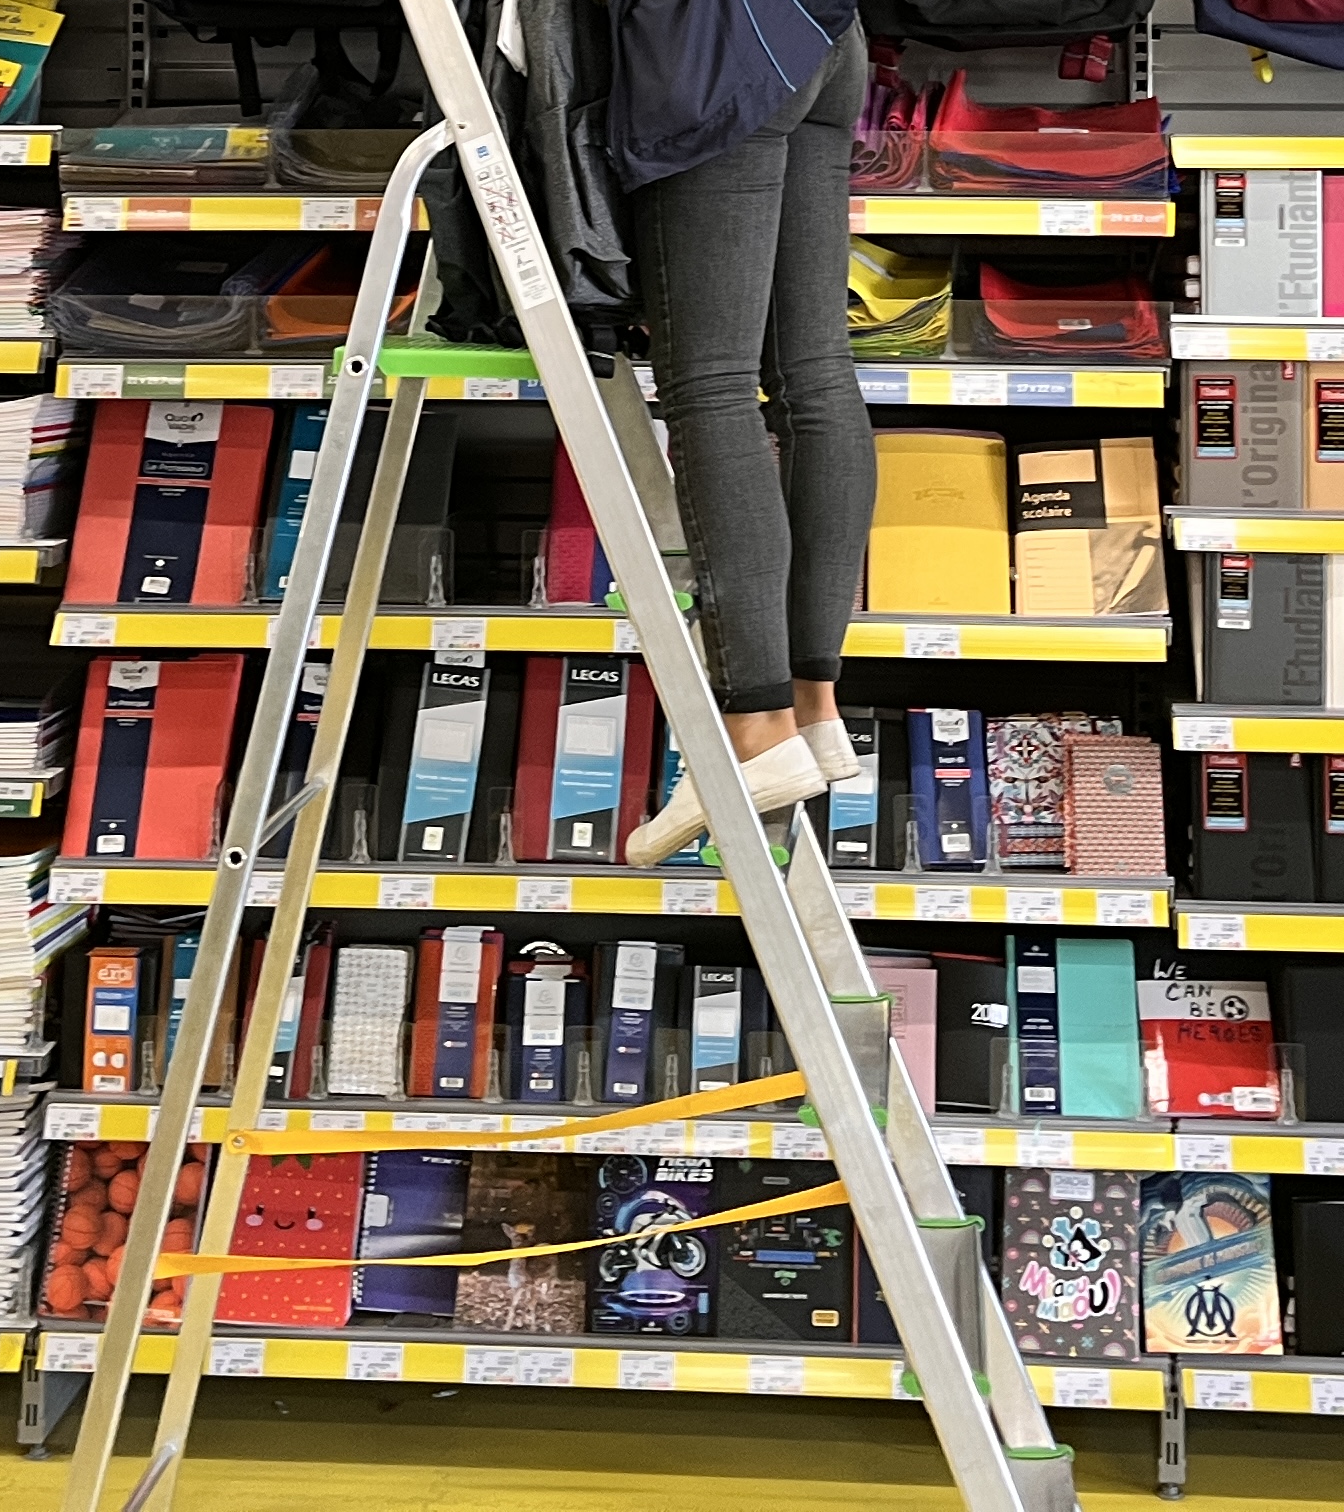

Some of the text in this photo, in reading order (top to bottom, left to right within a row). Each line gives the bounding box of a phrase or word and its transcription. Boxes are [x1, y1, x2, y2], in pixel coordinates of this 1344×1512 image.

[1021, 490, 1071, 506] Agenda
[1022, 505, 1073, 519] scolaire
[431, 672, 480, 688] LECAS
[570, 668, 620, 683] LECAS
[701, 971, 735, 984] LECAS
[1153, 958, 1187, 981] WE
[1165, 983, 1214, 1002] CAN
[1189, 1001, 1217, 1019] BE
[1177, 1023, 1264, 1044] HEROES
[654, 1166, 715, 1184] BIKES
